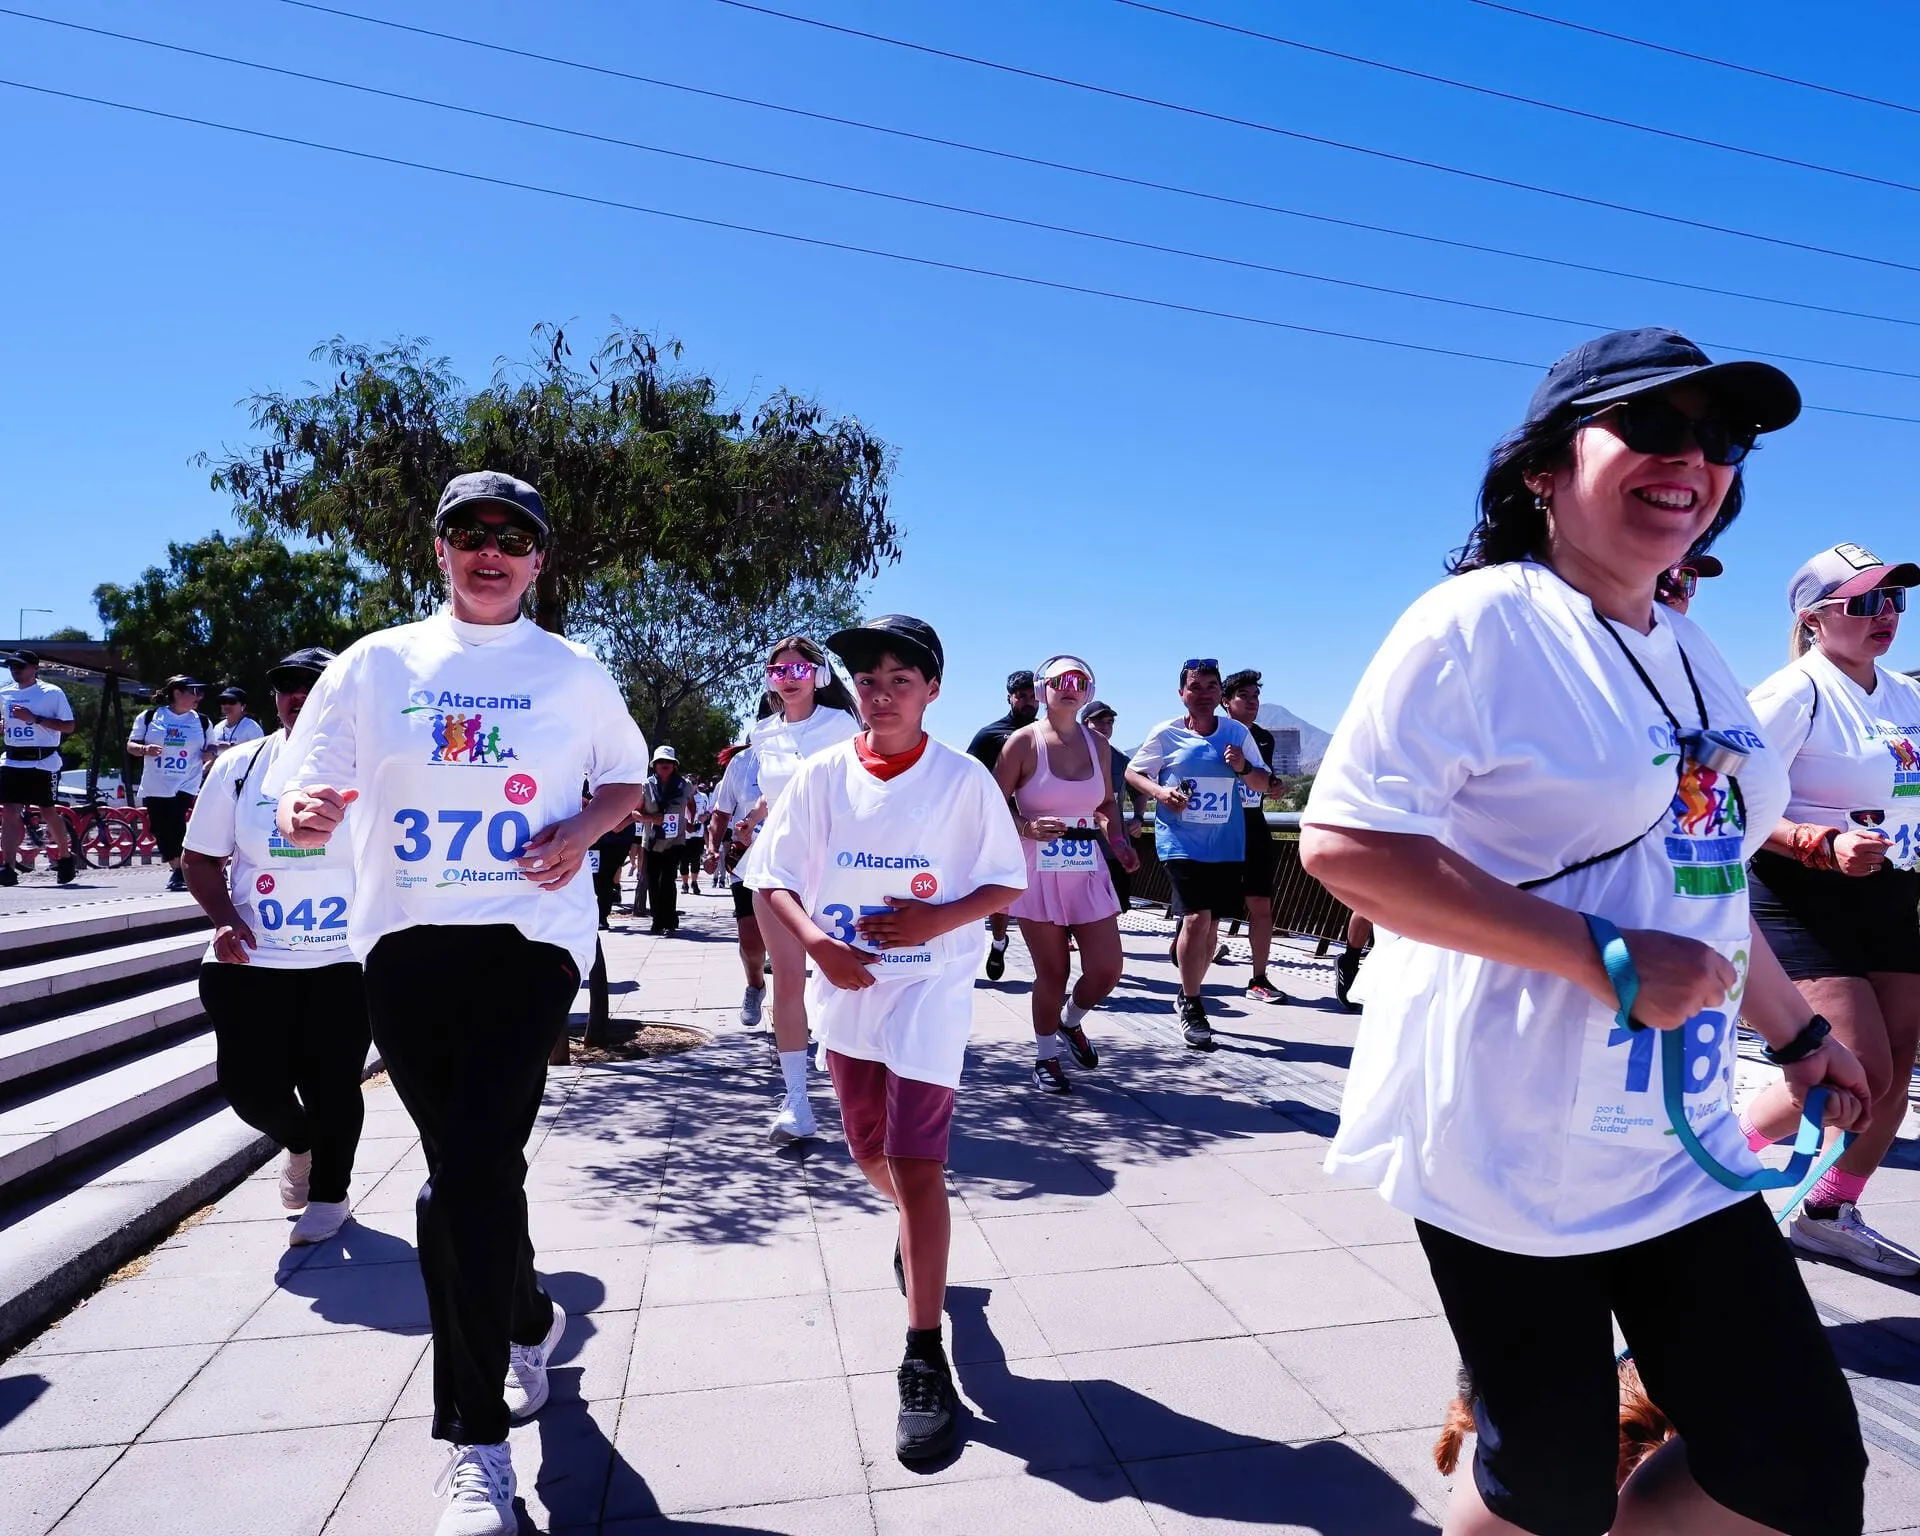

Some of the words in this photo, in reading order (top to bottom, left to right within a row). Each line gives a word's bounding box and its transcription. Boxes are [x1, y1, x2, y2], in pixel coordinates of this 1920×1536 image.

[437, 691, 531, 710] Atacama
[1876, 725, 1920, 735] Atacam
[154, 757, 188, 769] 120
[508, 780, 533, 798] 3K
[1187, 792, 1228, 811] 521
[393, 808, 531, 863] 370
[1041, 838, 1093, 857] 389
[854, 852, 930, 869] Atacama
[258, 878, 273, 891] 3K
[914, 880, 934, 892] 3K
[257, 896, 348, 932] 042
[303, 933, 348, 944] Atacama
[880, 952, 932, 964] Atacama
[1607, 1010, 1738, 1095] 18
[1593, 1115, 1611, 1125] por
[1613, 1116, 1654, 1127] nuestra
[1591, 1124, 1629, 1134] ciudad
